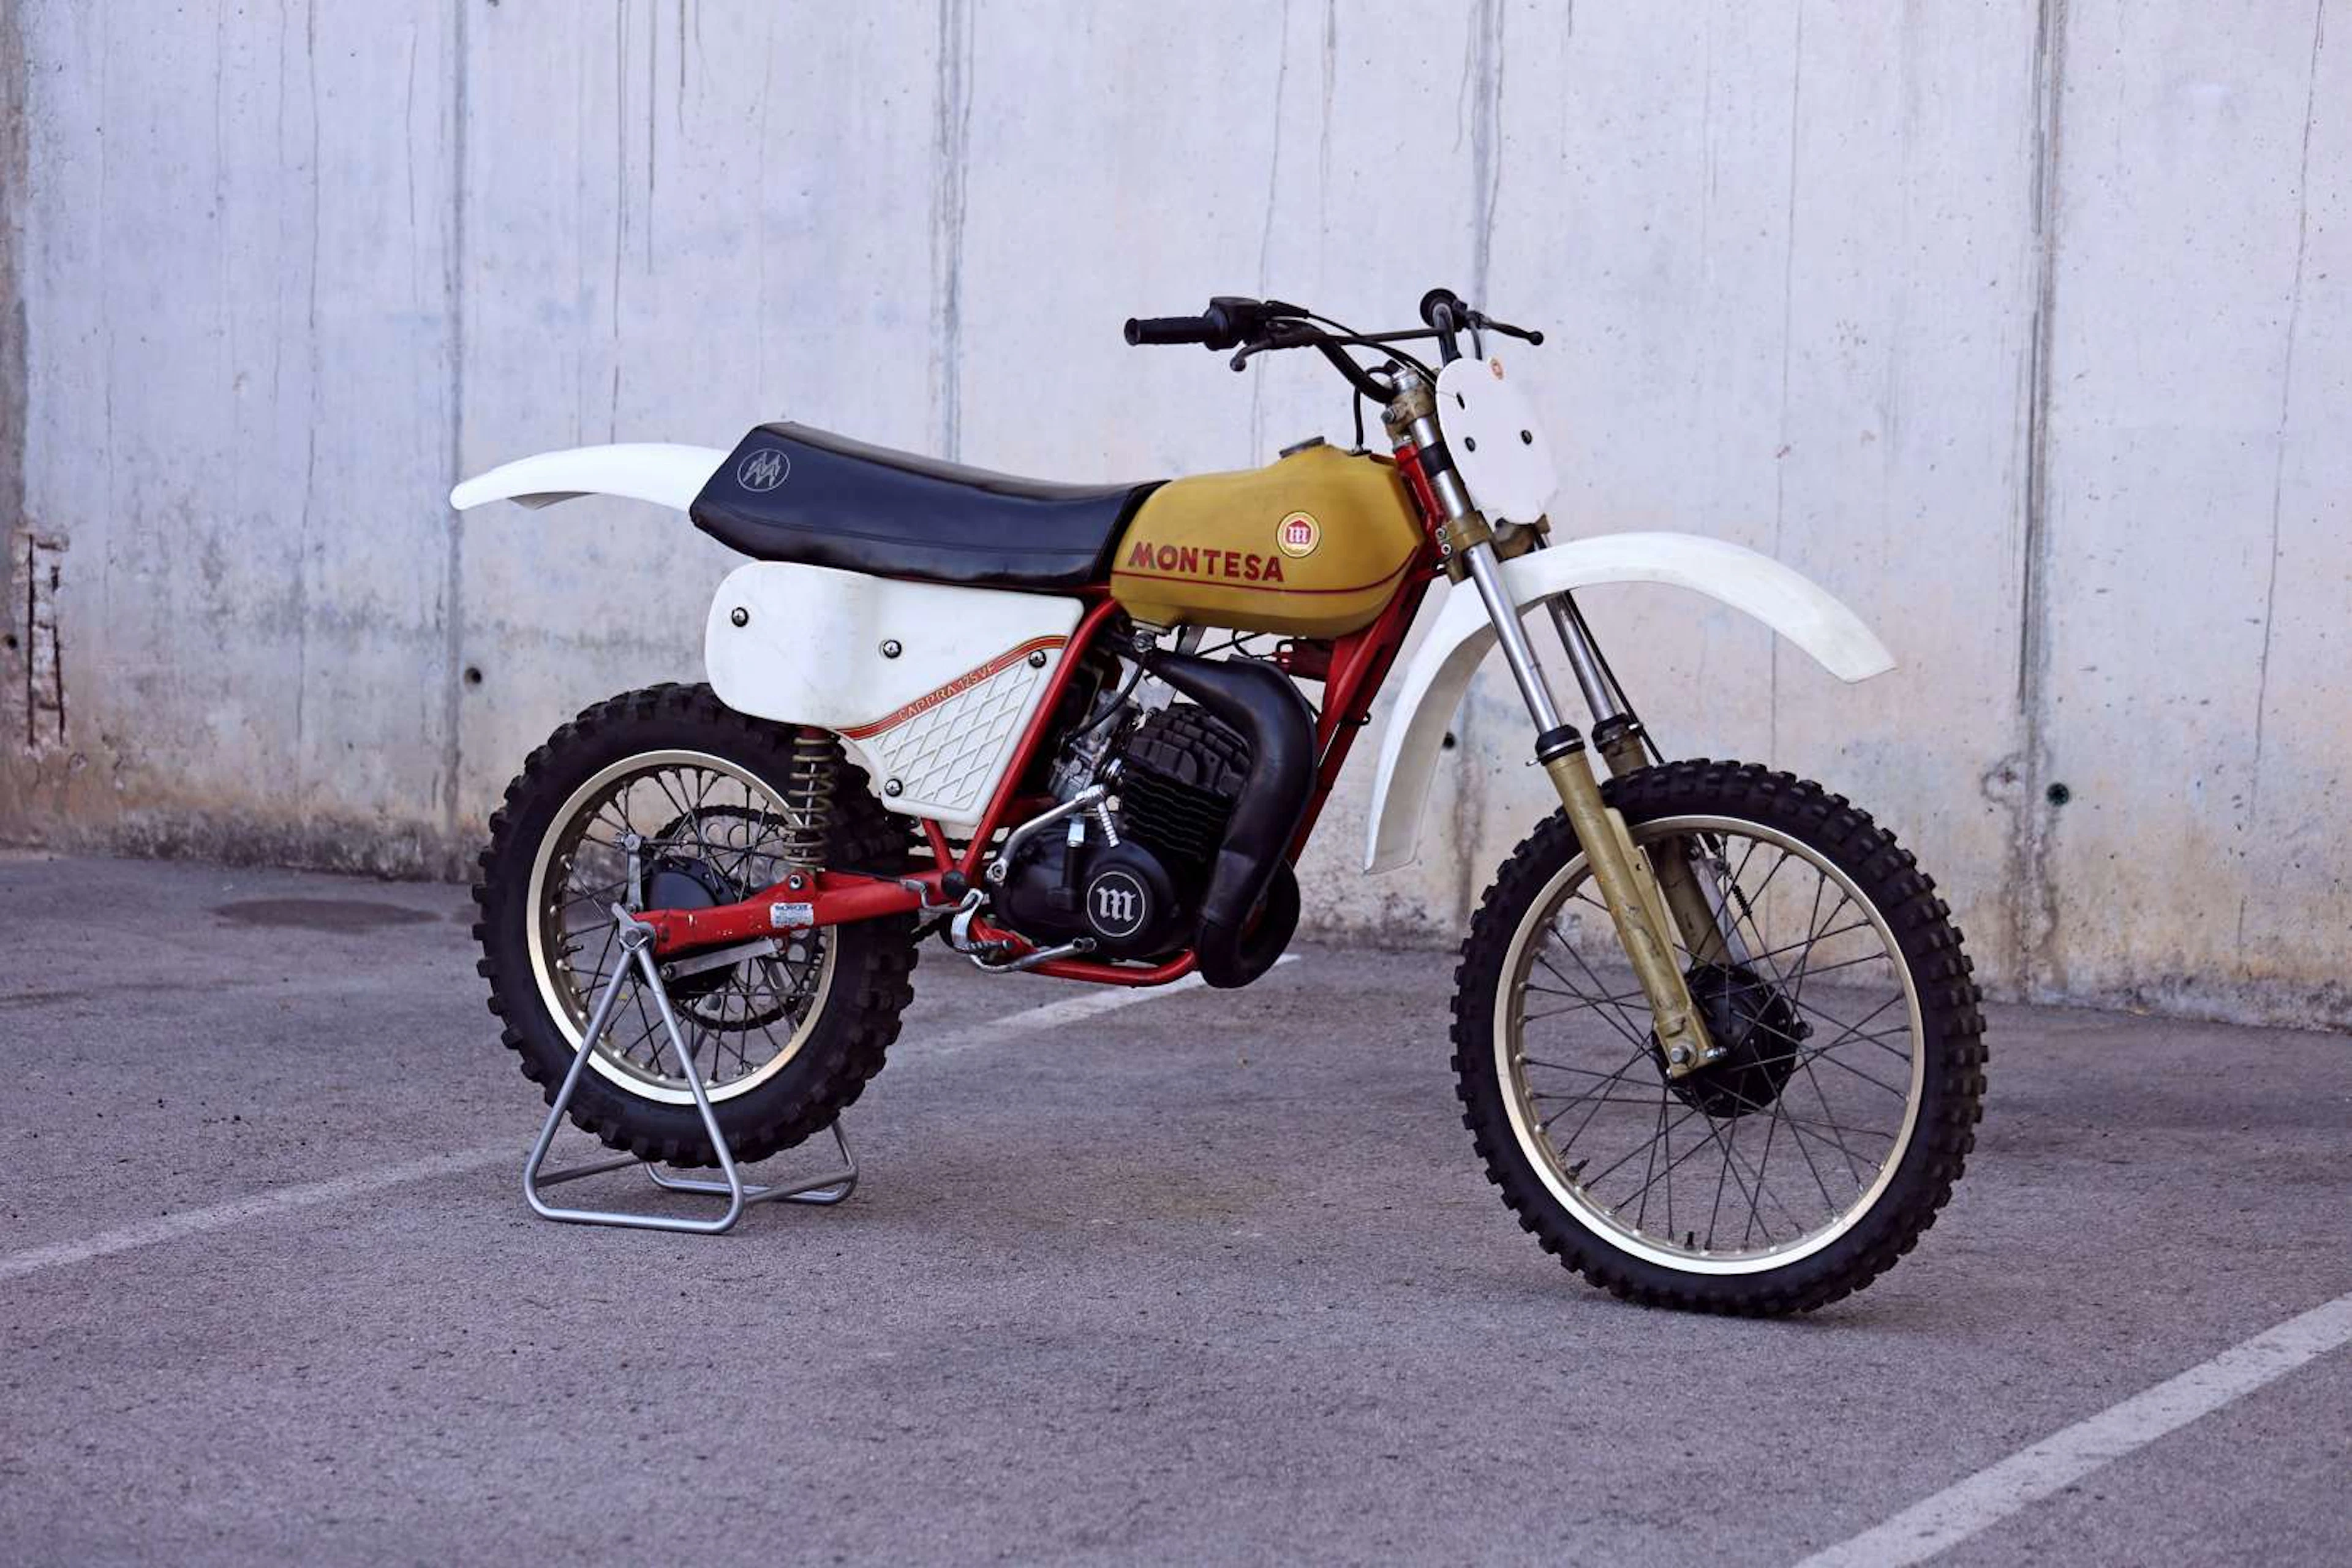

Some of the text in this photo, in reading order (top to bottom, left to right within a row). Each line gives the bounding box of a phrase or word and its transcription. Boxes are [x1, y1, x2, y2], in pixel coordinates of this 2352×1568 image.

[1128, 541, 1284, 582] MONTESA
[898, 687, 959, 721] CAPPRA
[959, 673, 978, 688] 125
